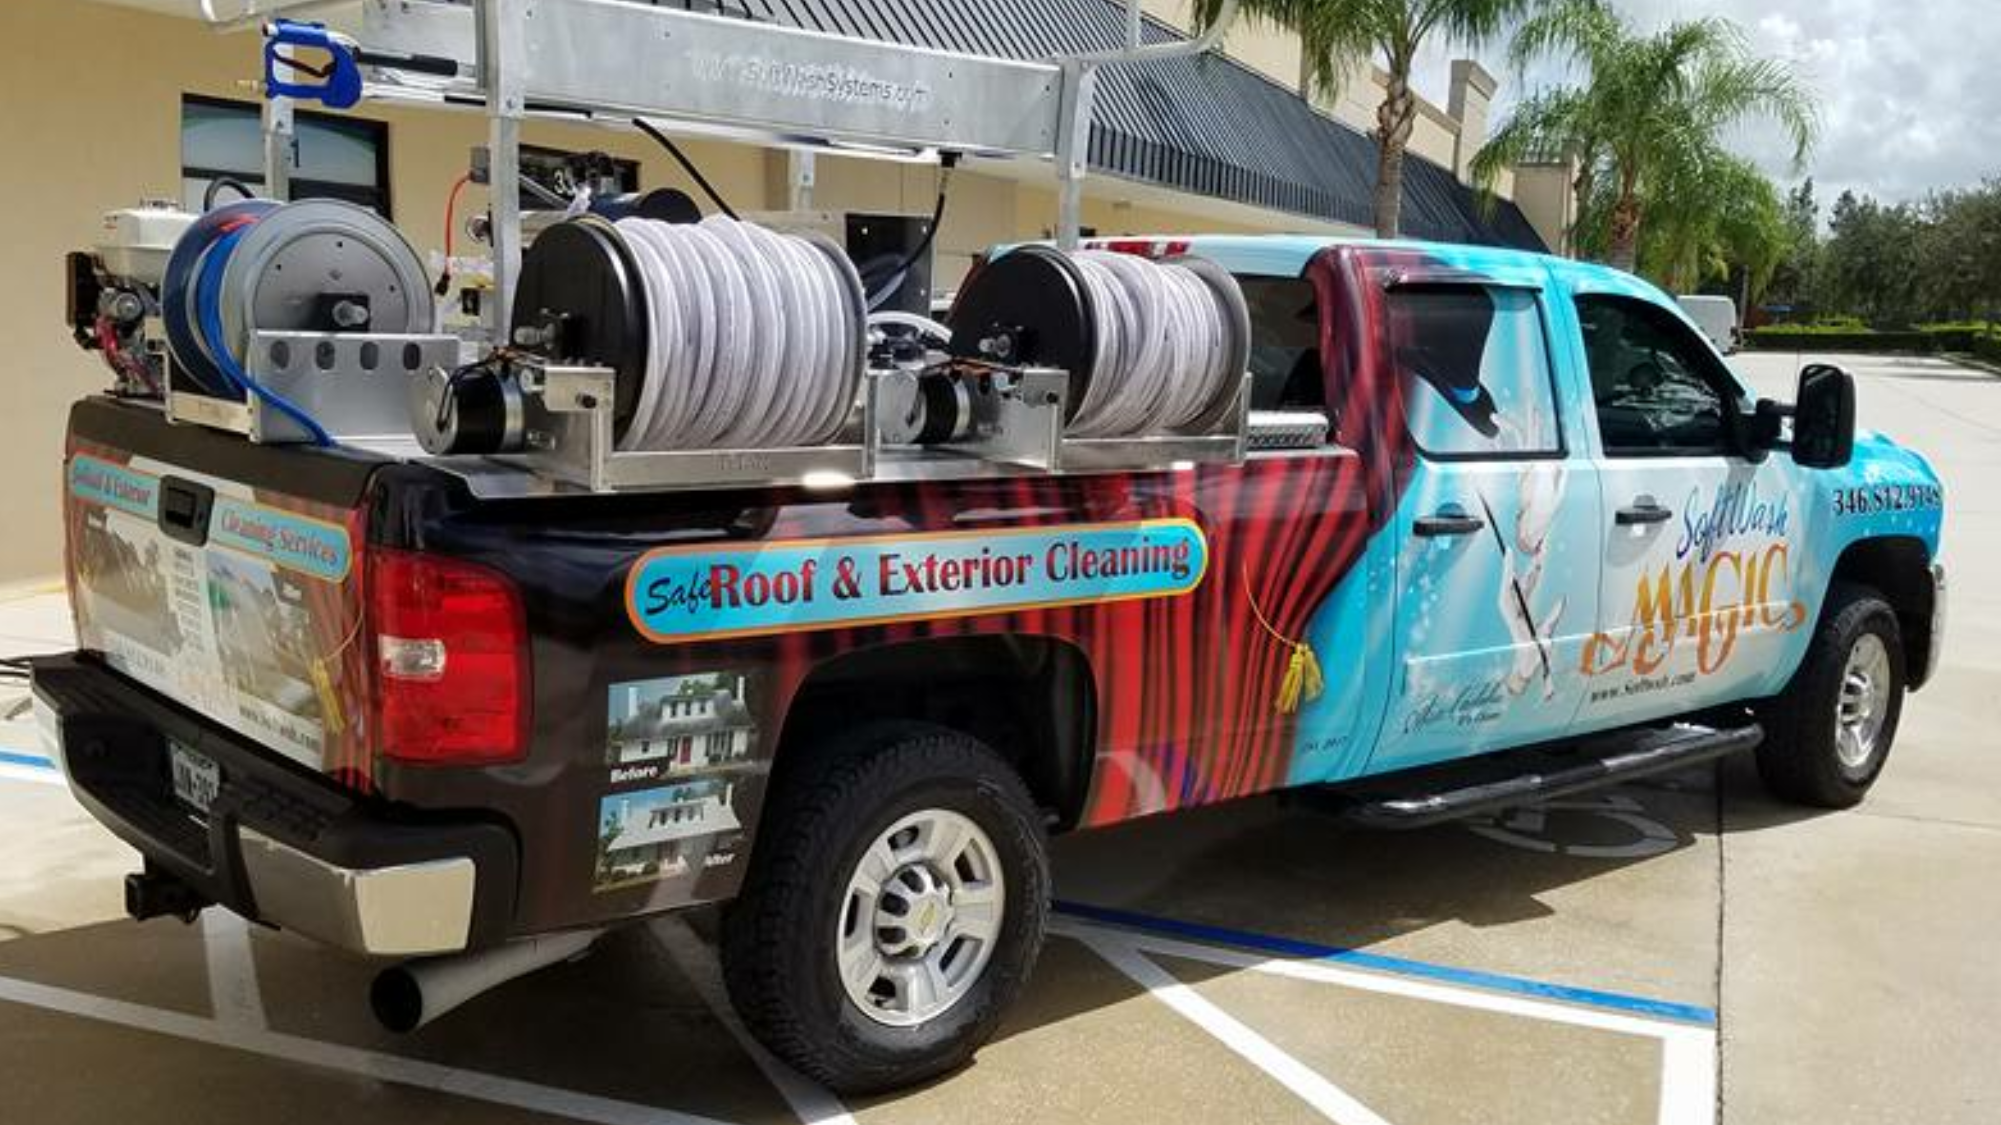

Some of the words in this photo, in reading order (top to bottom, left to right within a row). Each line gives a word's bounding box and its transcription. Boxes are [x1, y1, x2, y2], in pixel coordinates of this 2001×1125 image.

[221, 508, 274, 552] Cleaning
[280, 526, 338, 567] Services
[1676, 479, 1788, 563] SoftWash
[645, 572, 711, 617] Safe
[709, 558, 817, 609] Roof
[832, 556, 862, 600] &
[878, 547, 1033, 597] Exterior
[1045, 536, 1191, 580] Cleaning
[1580, 542, 1806, 675] MAGIC
[610, 765, 658, 783] Before
